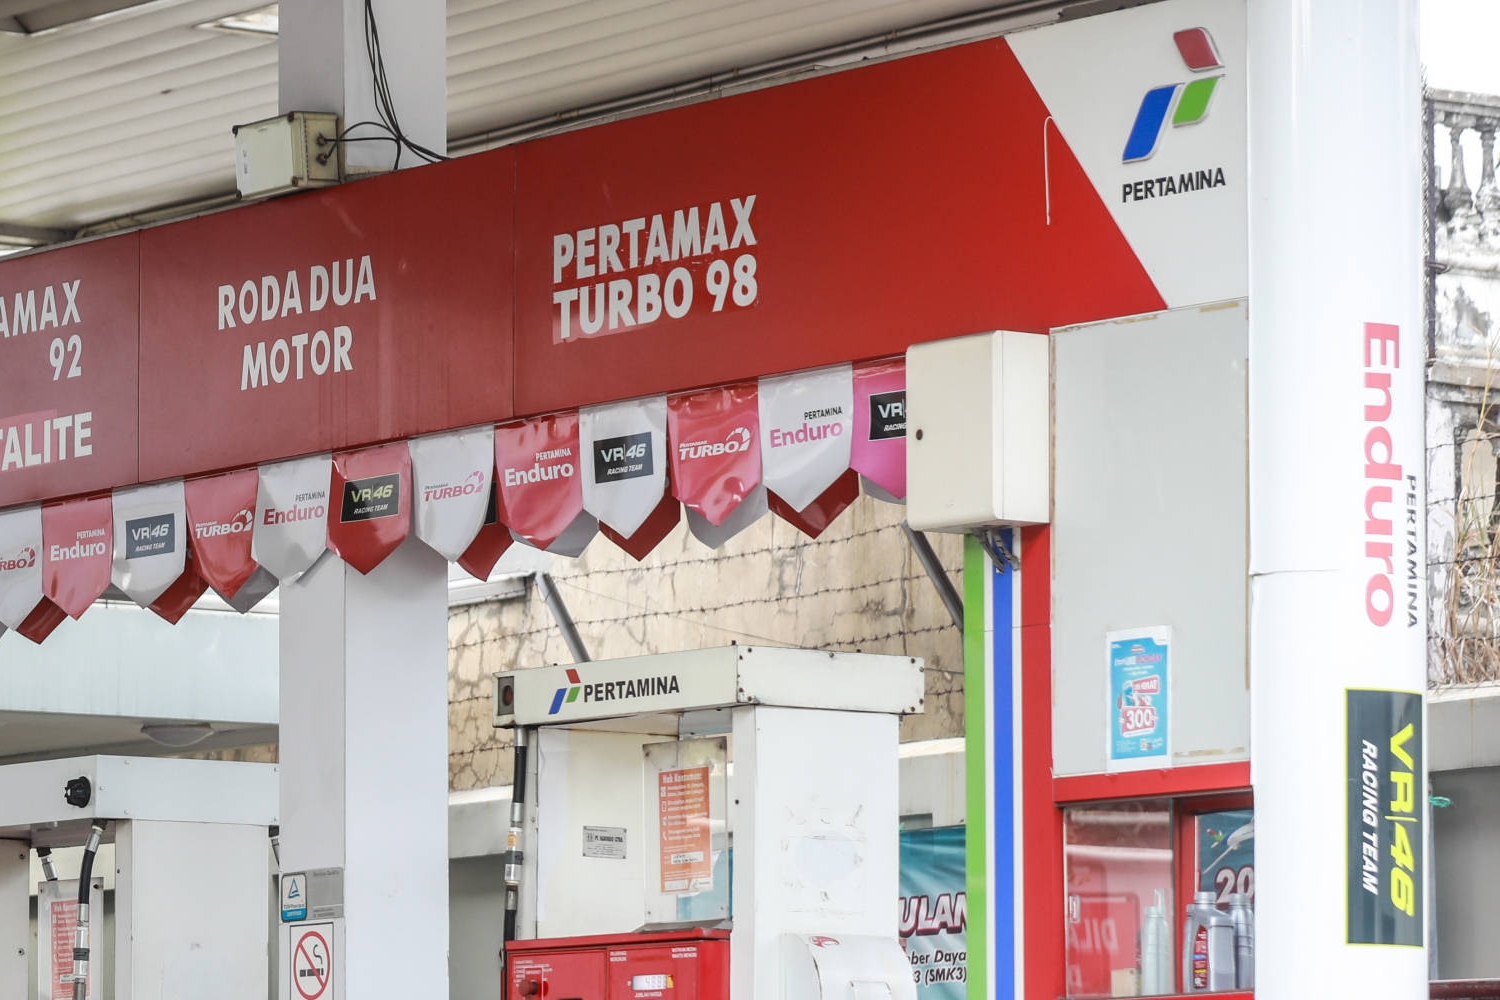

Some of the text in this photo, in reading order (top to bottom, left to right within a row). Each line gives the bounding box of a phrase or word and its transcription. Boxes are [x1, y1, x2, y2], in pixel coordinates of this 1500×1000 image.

[1121, 167, 1226, 203] PERTAMINA
[553, 195, 757, 283] PERTAMAX
[217, 255, 376, 330] RODA DUA
[553, 255, 758, 341] TURBO 98
[49, 335, 82, 381] 92
[241, 325, 353, 391] MOTOR
[804, 406, 843, 421] PERTAMINA
[770, 422, 843, 448] Enduro
[535, 448, 572, 462] PERTAMINA
[679, 441, 738, 461] TURBO
[504, 462, 574, 487] Enduro
[607, 463, 643, 476] RACING TEAM
[1363, 321, 1402, 626] Enduro
[295, 490, 326, 503] PERTAMINA
[424, 484, 475, 502] TURBO
[263, 504, 325, 526] Enduro
[353, 503, 388, 515] RACING TEAM
[76, 527, 105, 539] PERTAMINA
[195, 522, 243, 538] TURBO
[50, 541, 106, 562] Enduro
[1406, 474, 1417, 627] PERTAMINA
[584, 675, 680, 703] PERTAMINA
[1126, 709, 1152, 730] 300
[1362, 739, 1378, 894] RACING TEAM
[908, 950, 966, 965] ber Daya
[925, 967, 967, 985] (SMK3)
